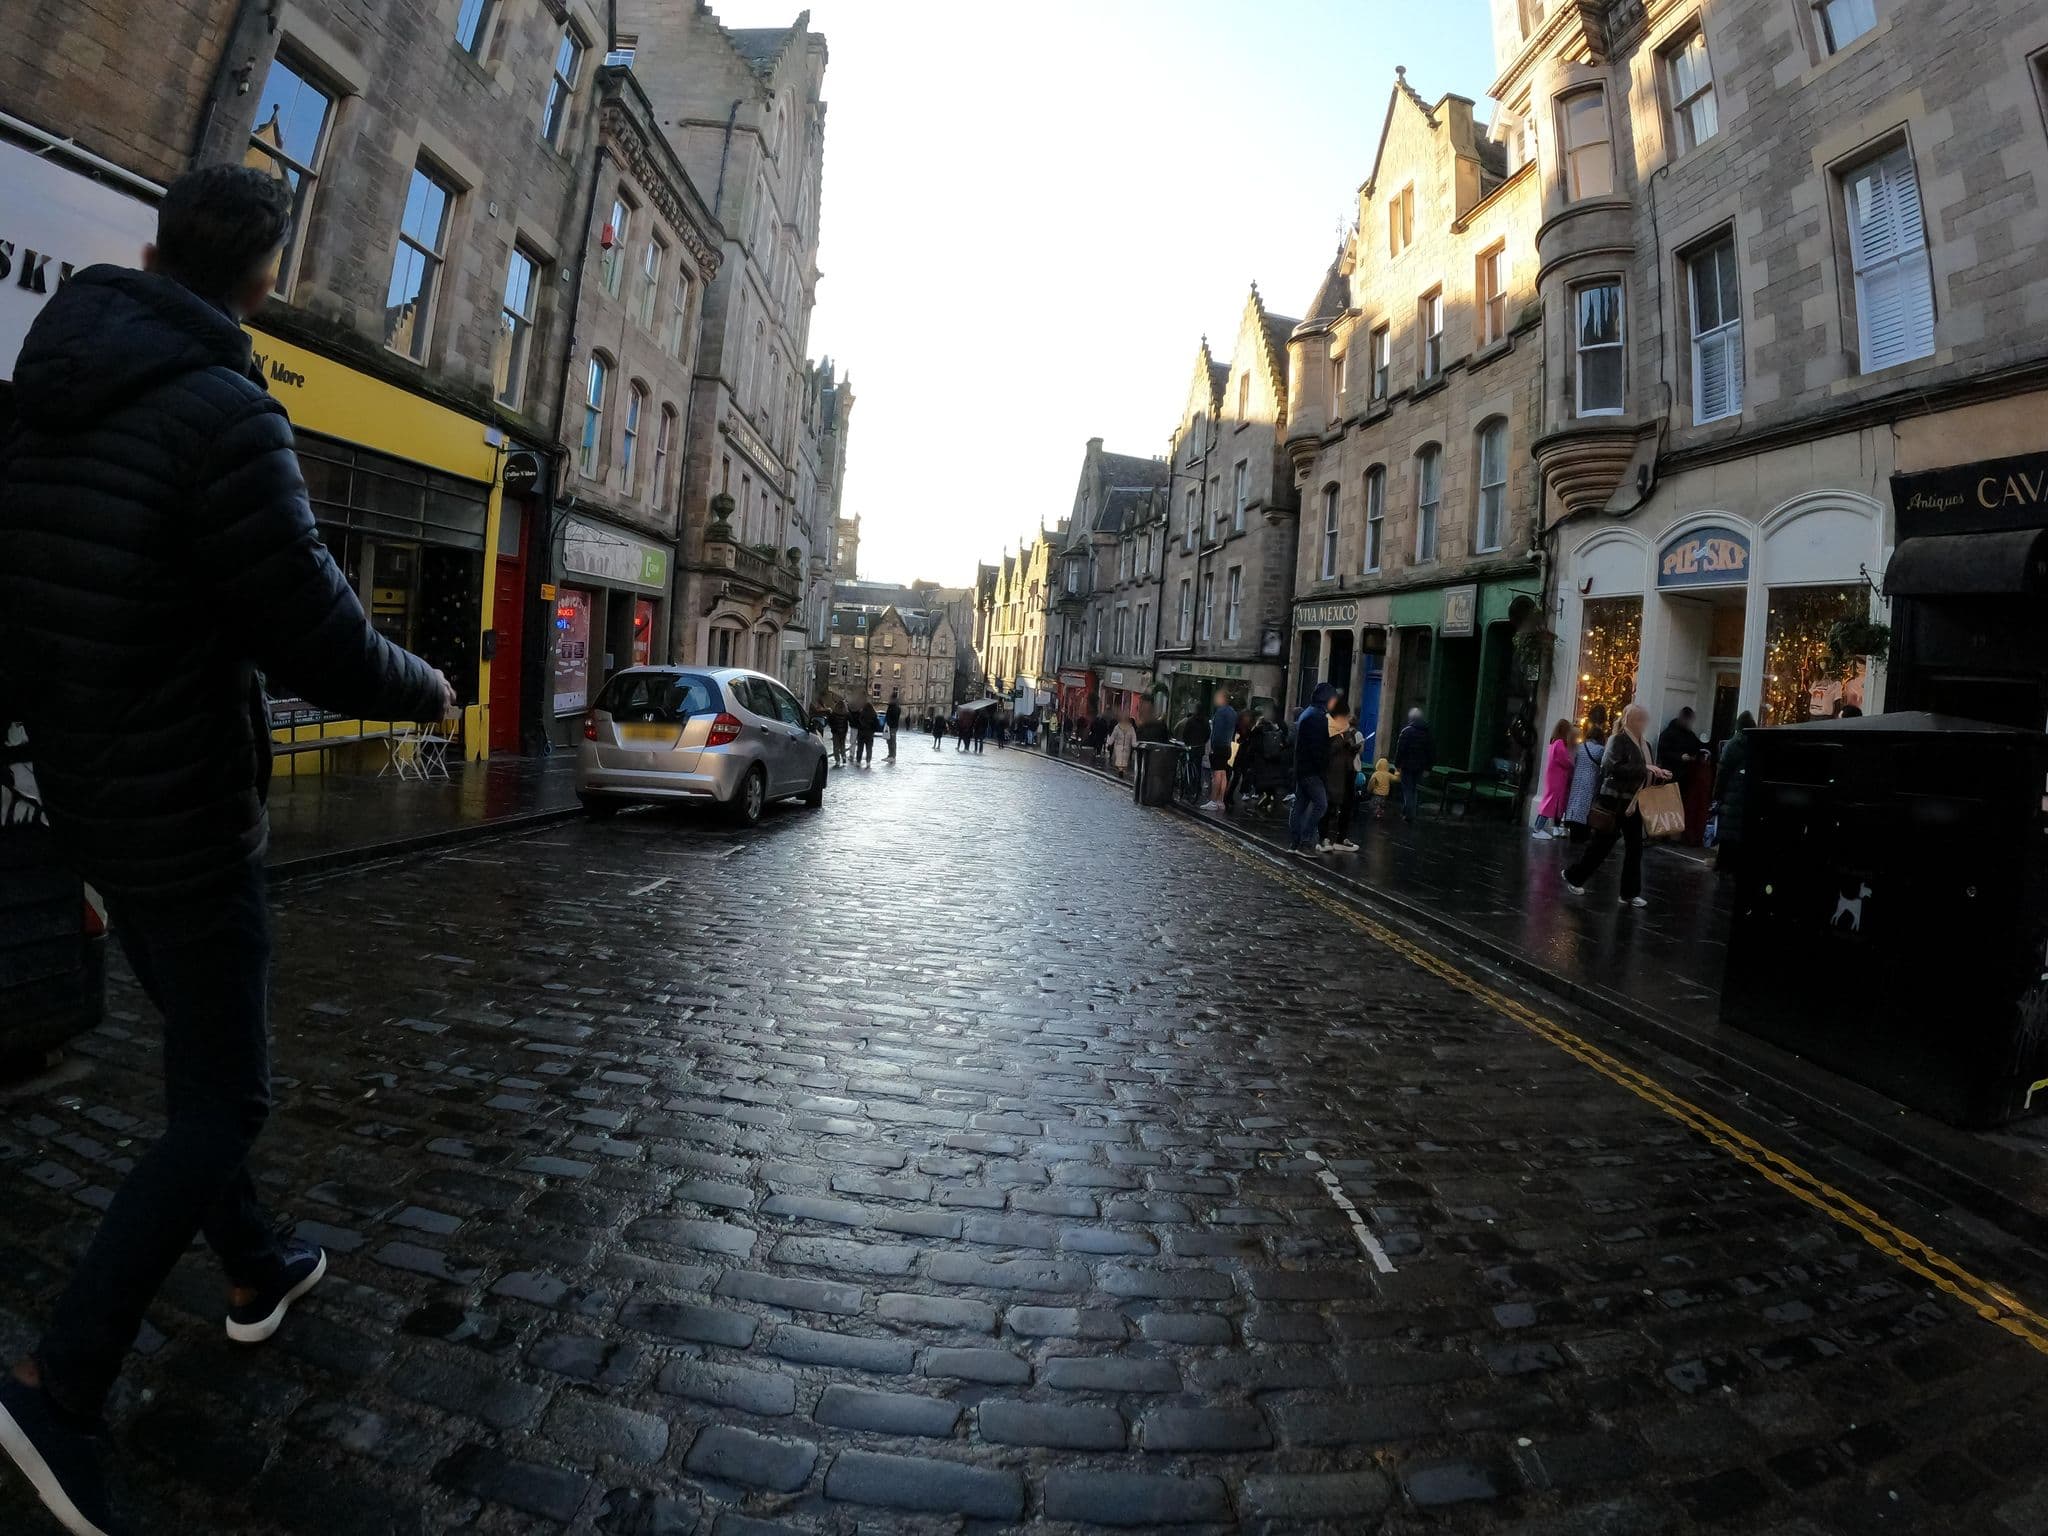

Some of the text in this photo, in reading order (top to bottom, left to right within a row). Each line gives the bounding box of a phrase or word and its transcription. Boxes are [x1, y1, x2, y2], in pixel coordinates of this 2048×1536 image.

[270, 359, 305, 388] More
[1906, 491, 1966, 512] Antiques
[1662, 538, 1748, 576] PIE SKY
[1299, 604, 1356, 622] VIVA MEXICO
